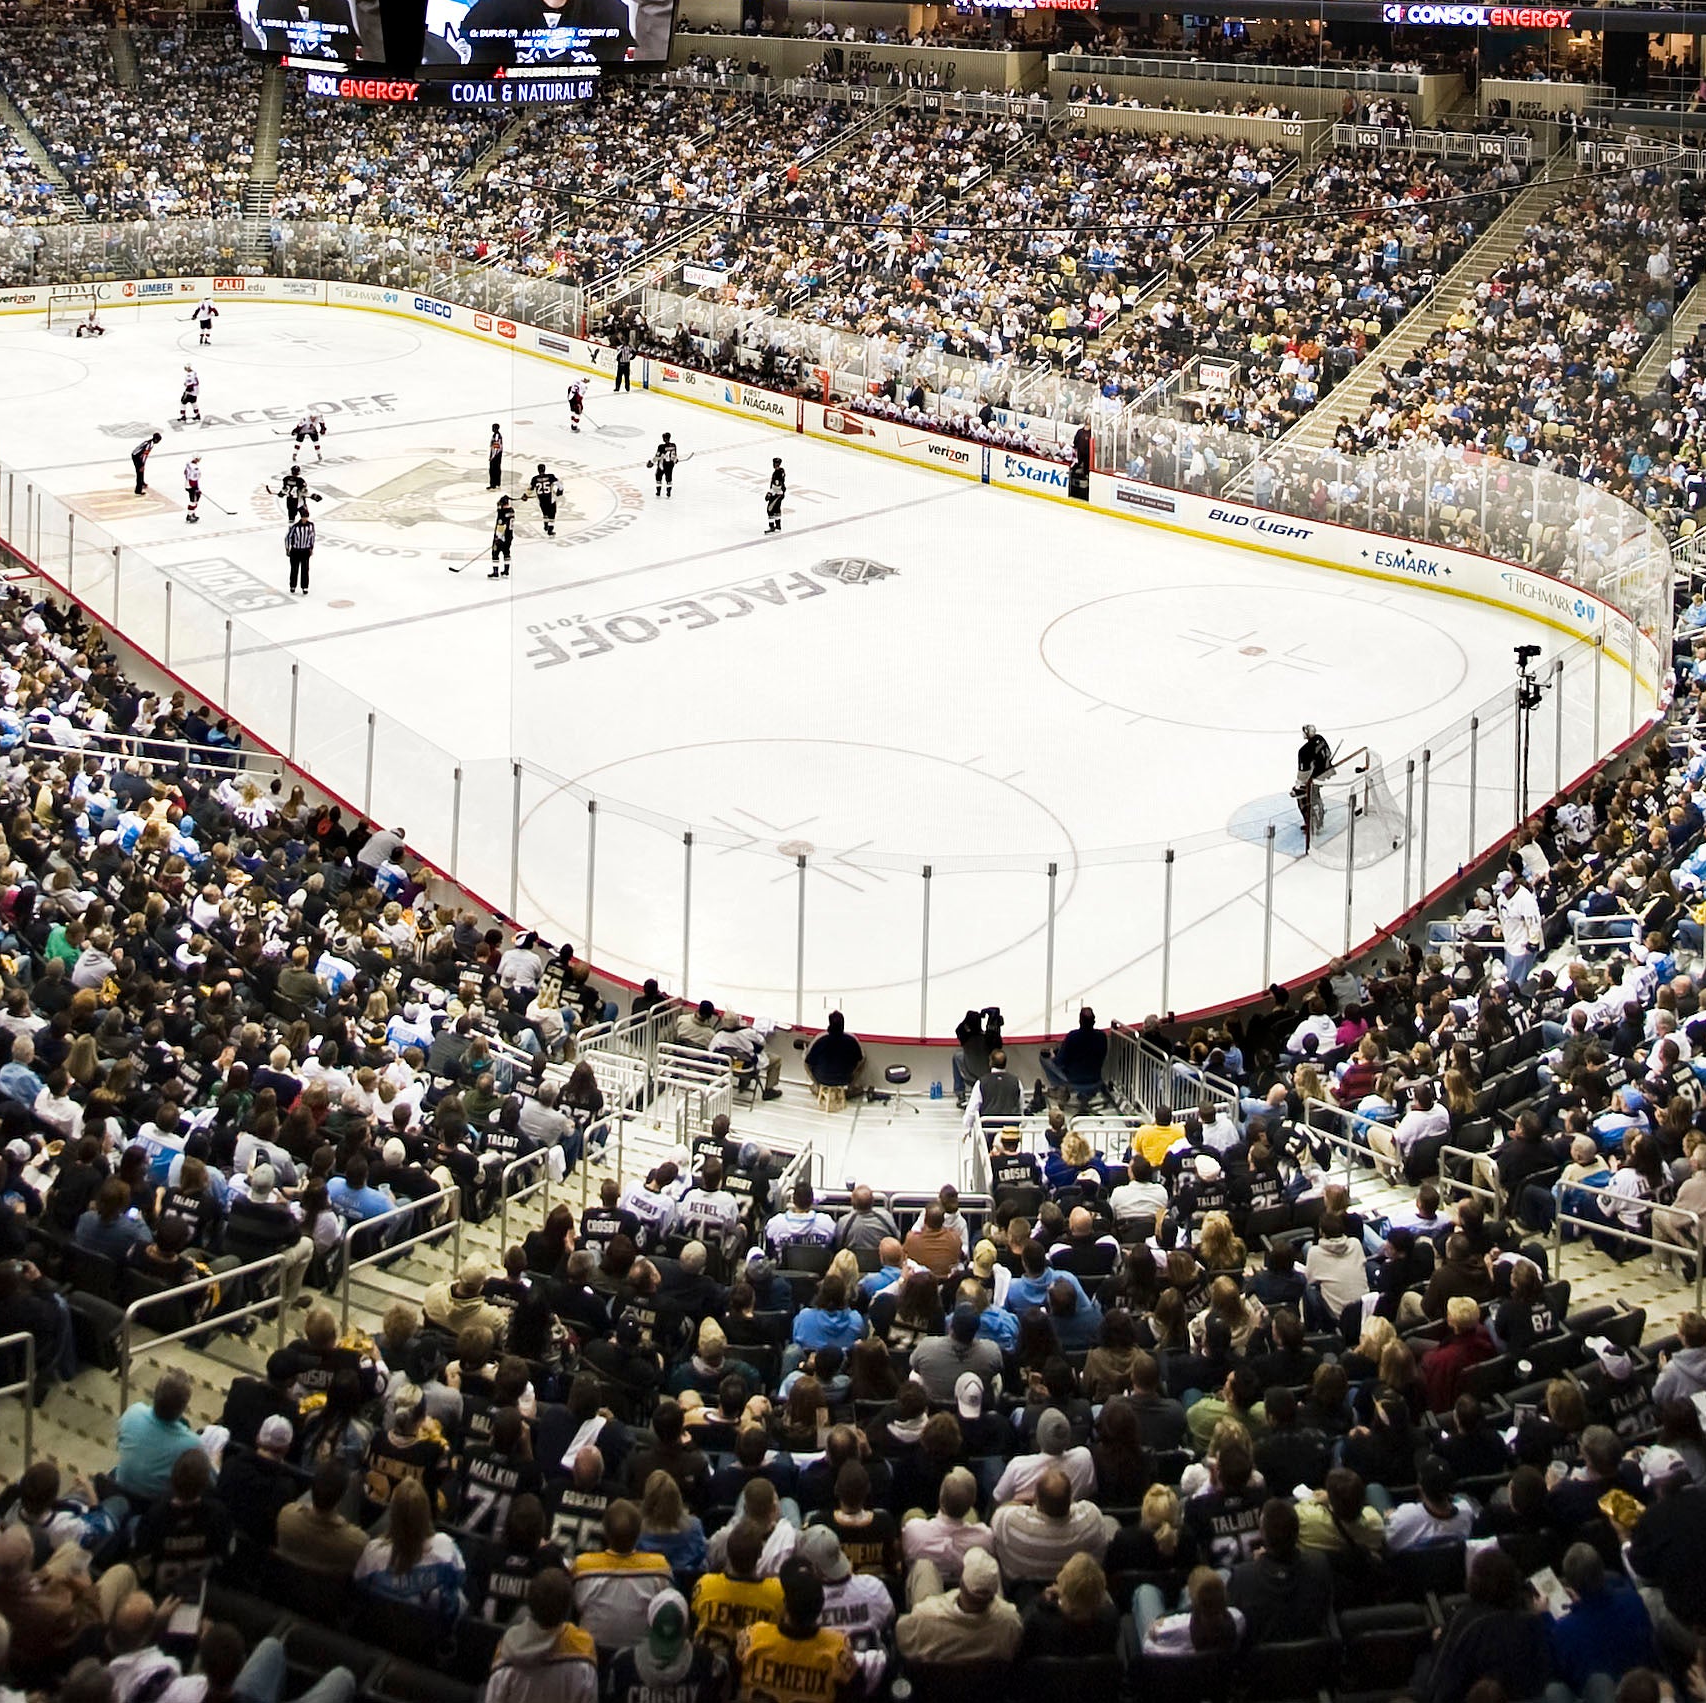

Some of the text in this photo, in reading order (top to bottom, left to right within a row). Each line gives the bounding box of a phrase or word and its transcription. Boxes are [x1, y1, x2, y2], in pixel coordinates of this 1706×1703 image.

[1408, 6, 1489, 26] CONSOL
[850, 50, 871, 60] FIRST
[558, 66, 601, 76] ELECTRIC
[452, 80, 593, 102] COAL & NATURAL GAS
[850, 91, 864, 101] 122
[925, 97, 939, 108] 101
[1010, 104, 1025, 114] 101
[1518, 101, 1541, 110] FIRST
[1069, 106, 1086, 118] 102
[1282, 124, 1302, 136] 102
[1358, 133, 1379, 145] 103
[1479, 141, 1501, 155] 103
[1600, 150, 1626, 164] 104
[137, 283, 173, 295] LUMBER
[215, 279, 266, 292] CALU.edu
[415, 297, 452, 318] GEICO
[744, 389, 761, 398] FIRST
[353, 406, 396, 417] 2010
[743, 398, 785, 416] NIAGARA
[928, 444, 970, 462] verizon
[534, 482, 551, 494] 25
[1208, 509, 1313, 540] BUD LIGHT
[1375, 551, 1439, 576] ESMARK
[1508, 577, 1573, 613] HIGHMARK
[526, 570, 828, 670] FACE-OFF
[526, 614, 591, 635] 2010
[999, 1168, 1032, 1182] CROSBY
[1250, 1180, 1277, 1195] TALBOT
[587, 1220, 621, 1234] CROSBY
[1531, 1314, 1553, 1332] 87
[469, 1458, 519, 1489] MALKIN
[749, 1656, 829, 1695] LEMIEUX
